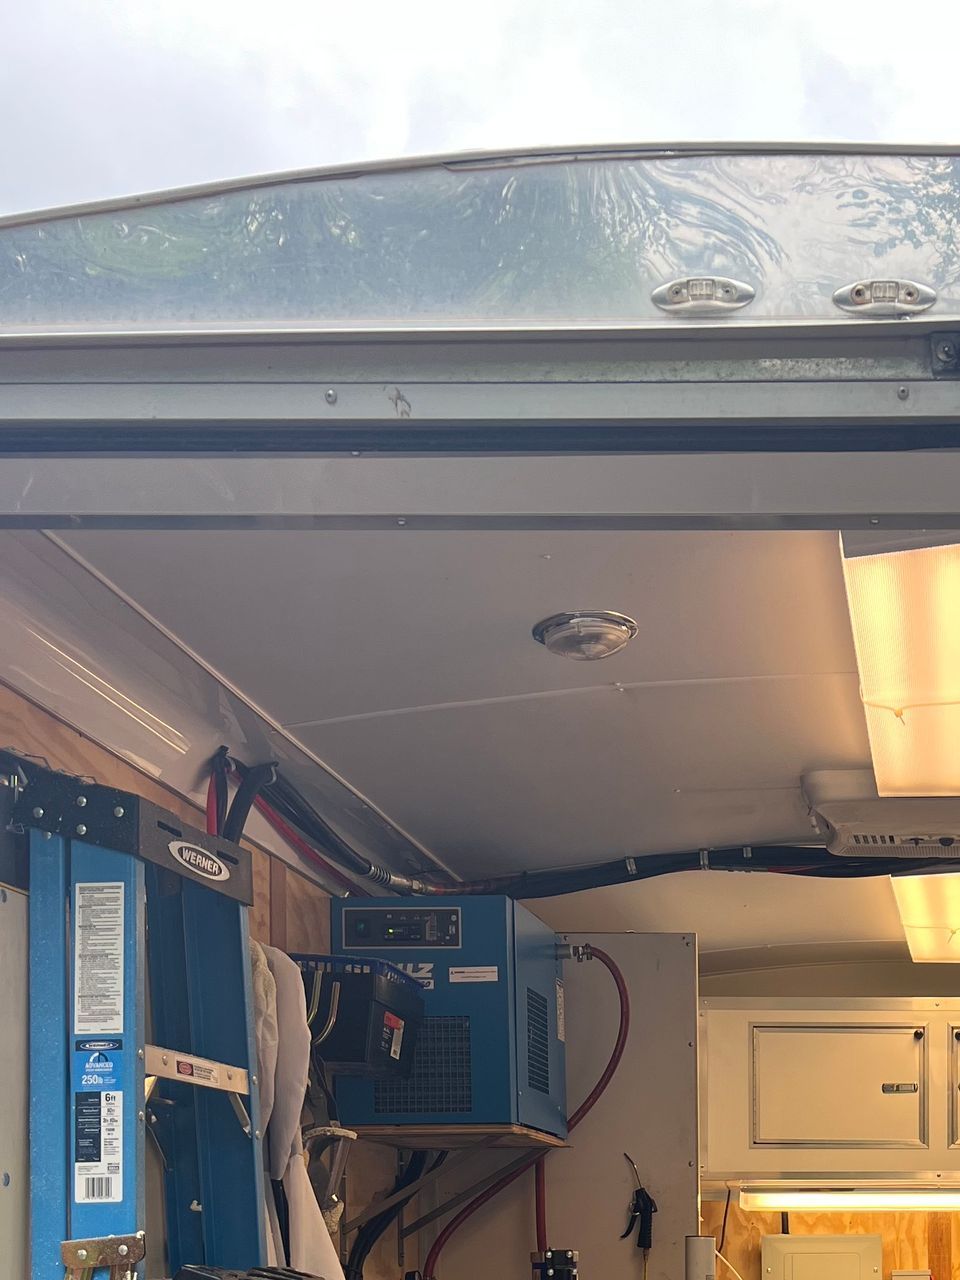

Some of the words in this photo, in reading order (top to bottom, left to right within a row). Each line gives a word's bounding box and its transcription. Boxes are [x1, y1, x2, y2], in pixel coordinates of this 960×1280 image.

[182, 847, 219, 875] WERNER
[82, 1075, 103, 1085] 250lb
[105, 1093, 116, 1102] 6ft
